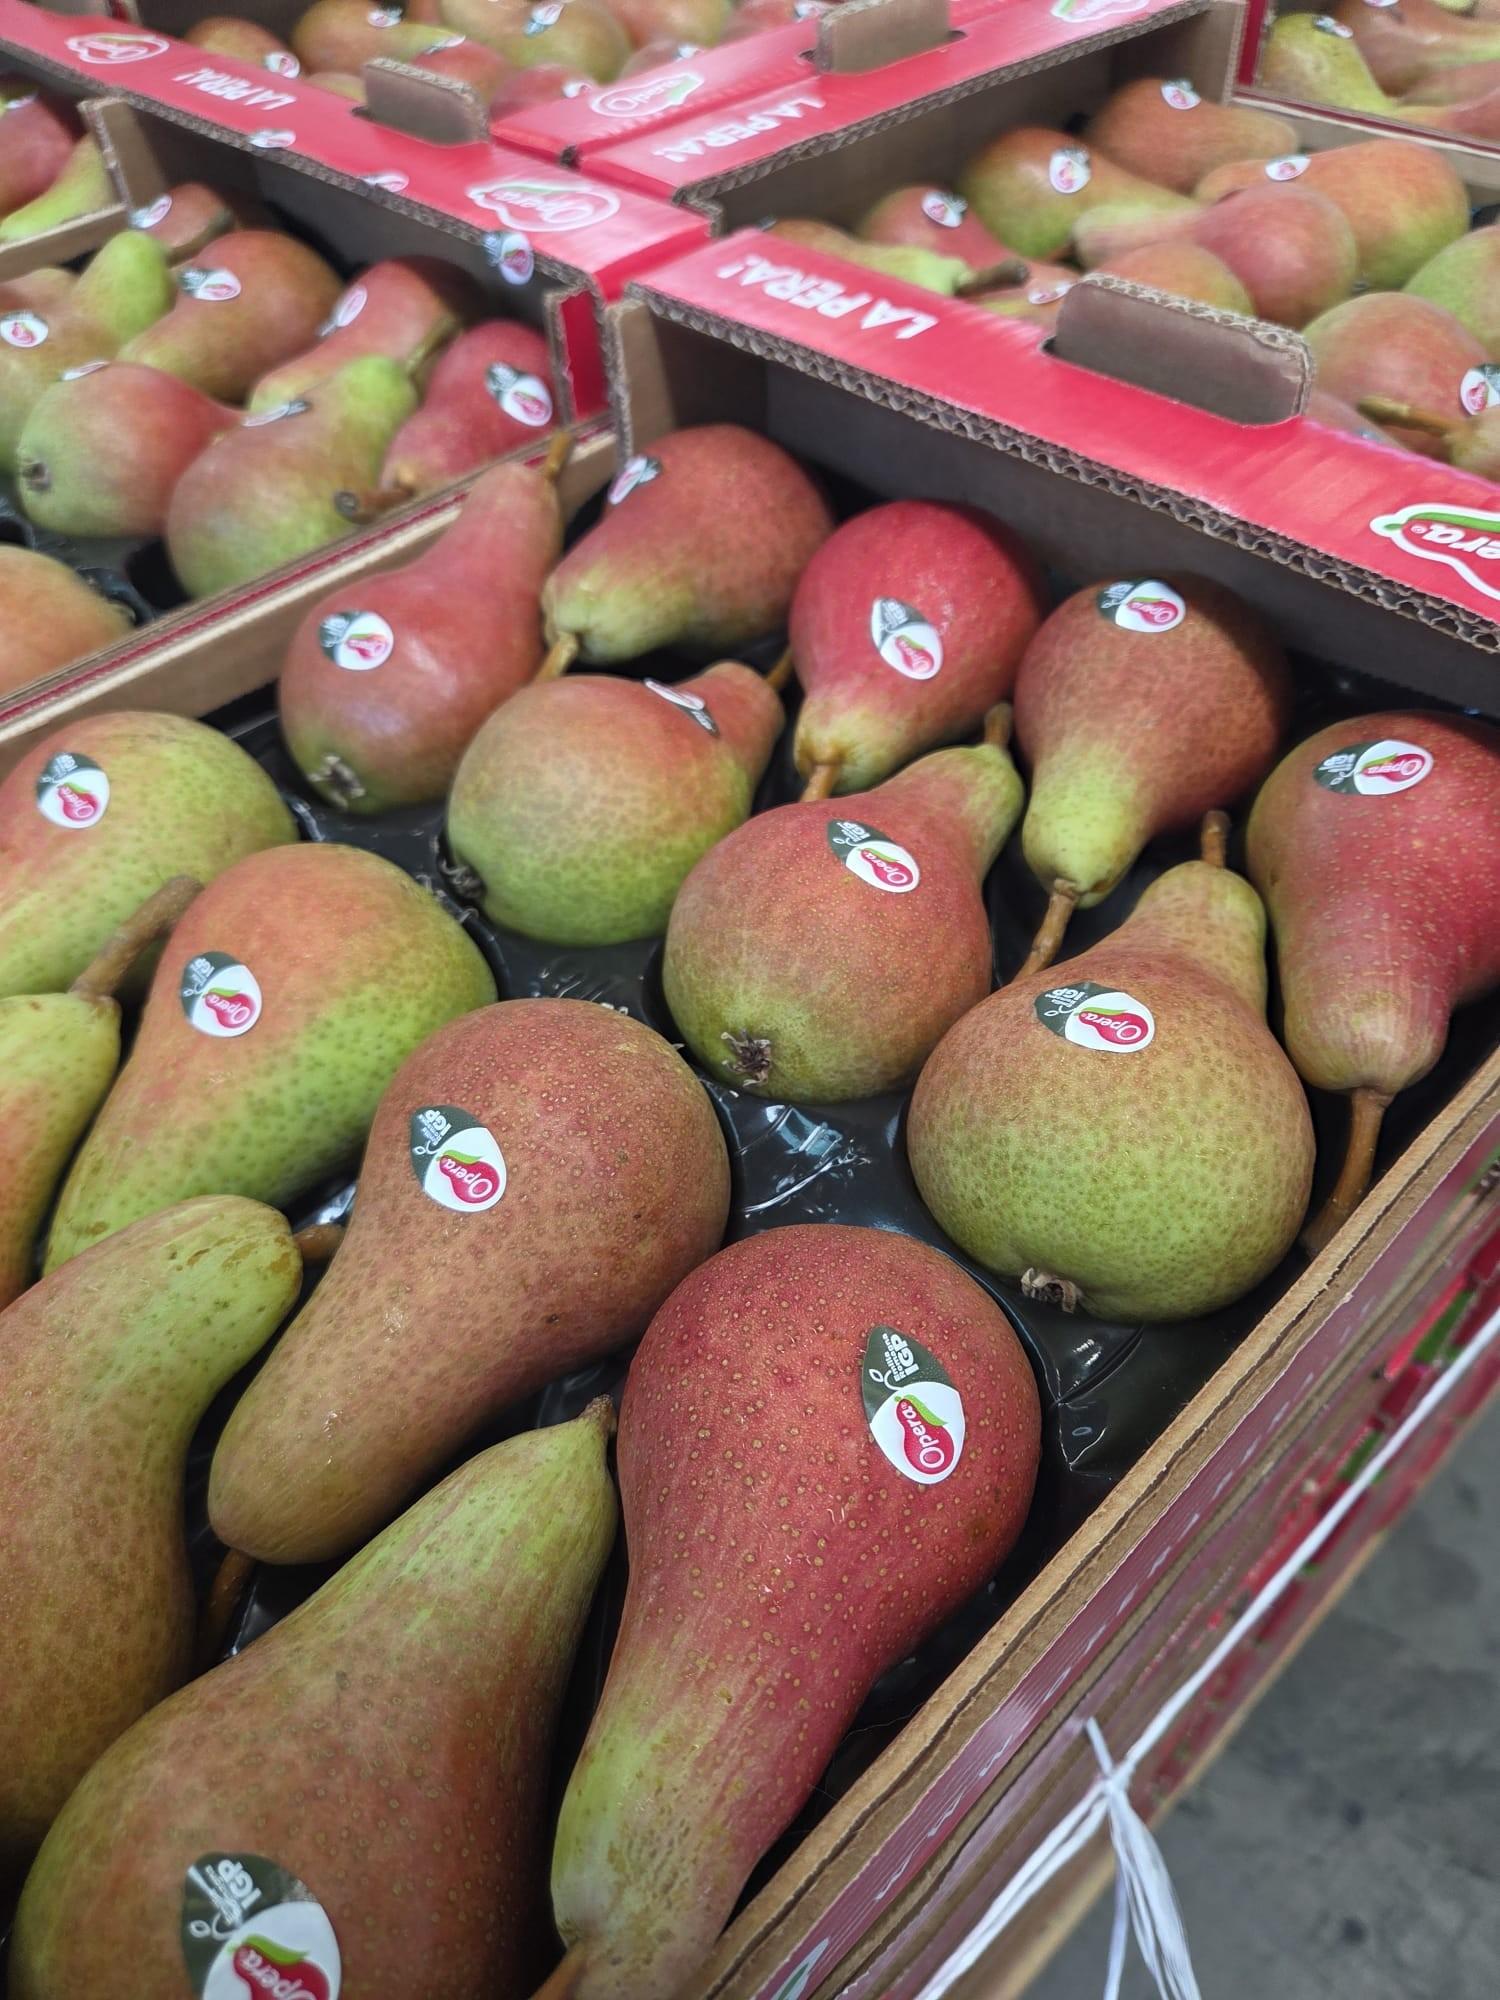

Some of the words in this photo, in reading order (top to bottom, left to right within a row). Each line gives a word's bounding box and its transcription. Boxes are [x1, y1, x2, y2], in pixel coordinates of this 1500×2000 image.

[716, 253, 874, 319] PERA!
[861, 298, 939, 340] LA
[1084, 1012, 1142, 1041] Opera
[424, 1109, 452, 1137] IGP
[444, 1158, 493, 1199] Opera
[890, 1333, 920, 1377] IGP
[902, 1404, 945, 1469] Opera
[218, 1859, 263, 1911] IGP
[241, 1949, 318, 2000] pera
